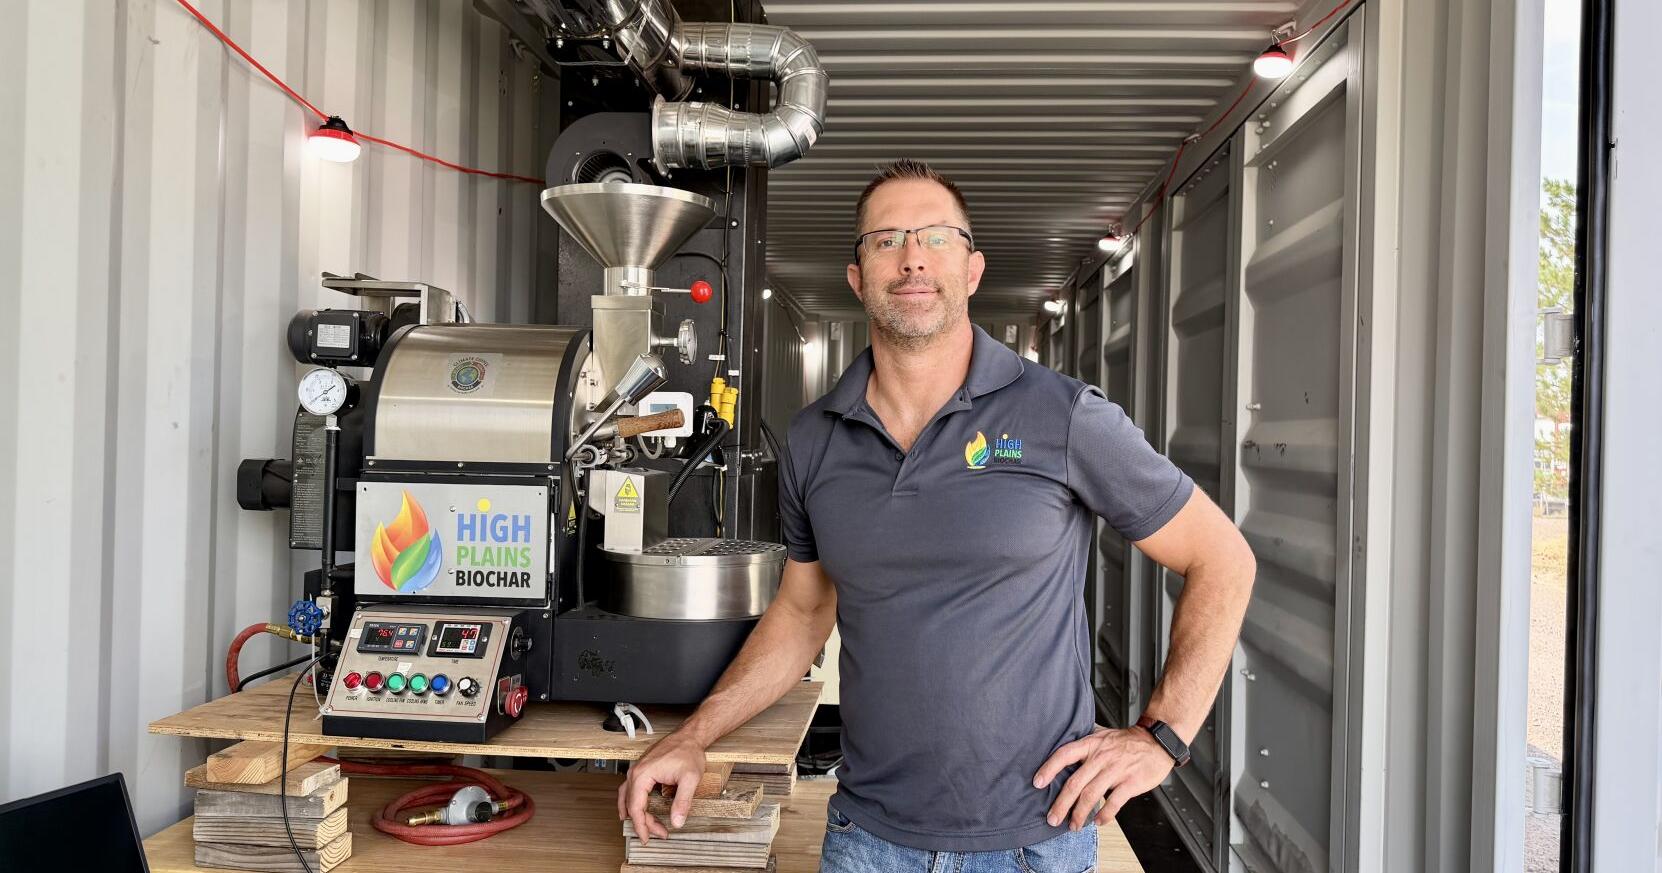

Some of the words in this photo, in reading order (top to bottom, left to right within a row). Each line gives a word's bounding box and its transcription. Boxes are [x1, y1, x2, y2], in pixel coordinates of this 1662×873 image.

[995, 434, 1022, 449] HIGH
[994, 449, 1022, 458] PLAINS
[457, 499, 531, 543] HIGH
[456, 546, 532, 568] PLAINS
[455, 570, 531, 588] BIOCHAR
